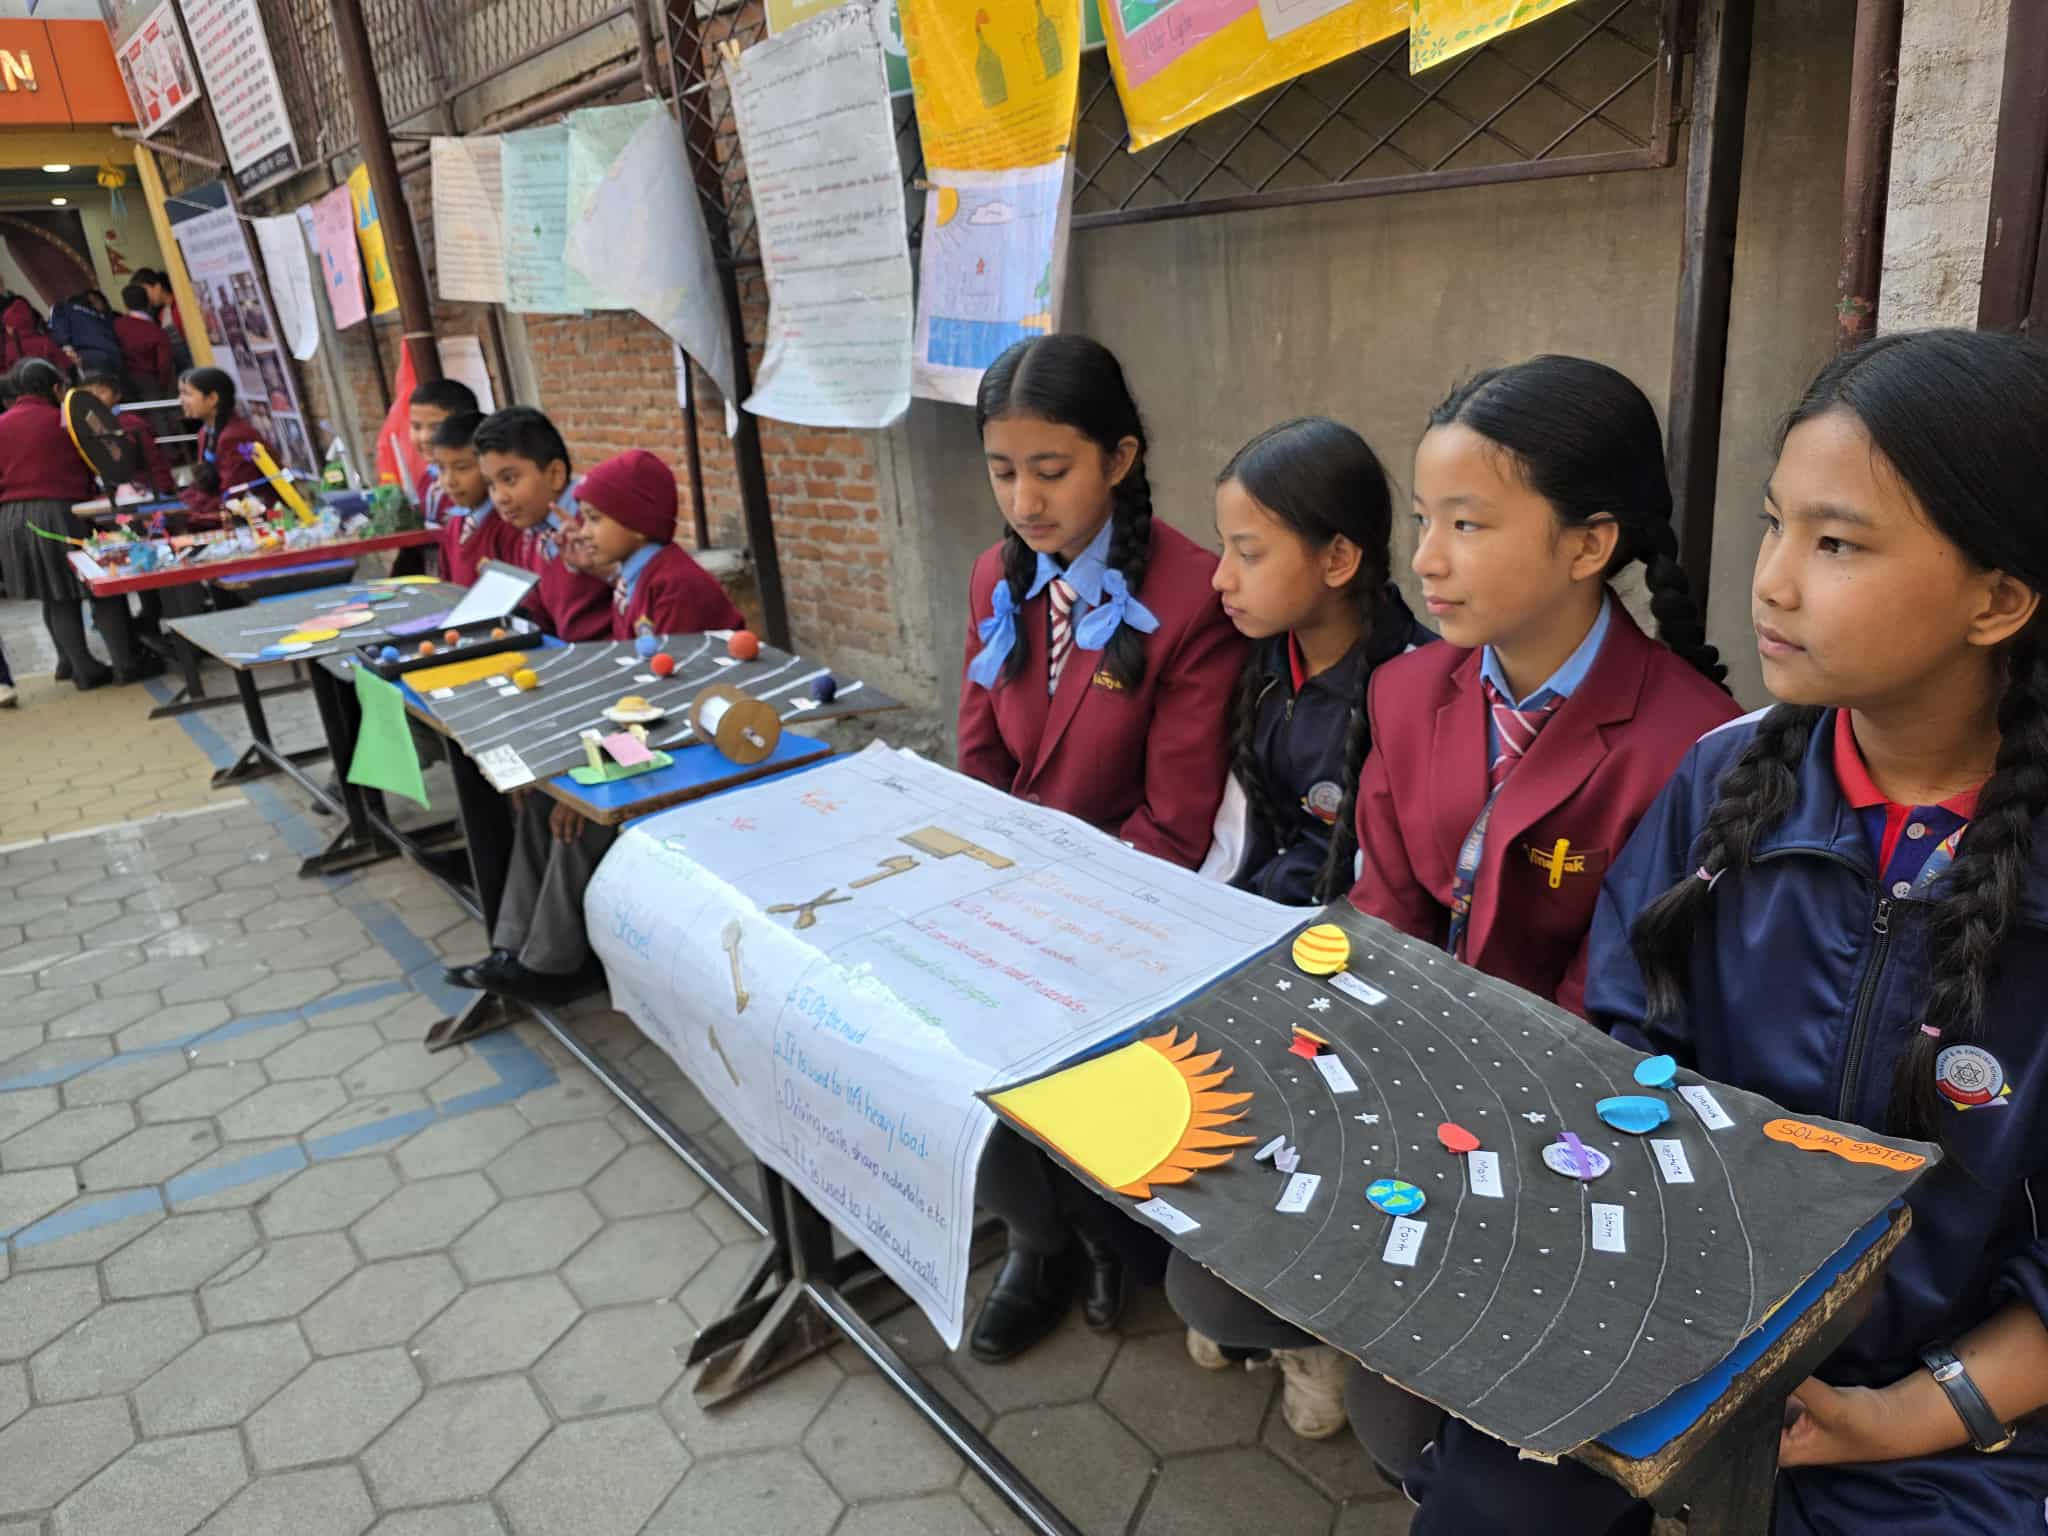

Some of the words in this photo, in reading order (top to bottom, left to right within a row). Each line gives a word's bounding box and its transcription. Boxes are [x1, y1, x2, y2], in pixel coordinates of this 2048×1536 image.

[0, 49, 39, 93] N
[1777, 1121, 1845, 1148] SOLAR
[1851, 1140, 1923, 1166] SYSTEM
